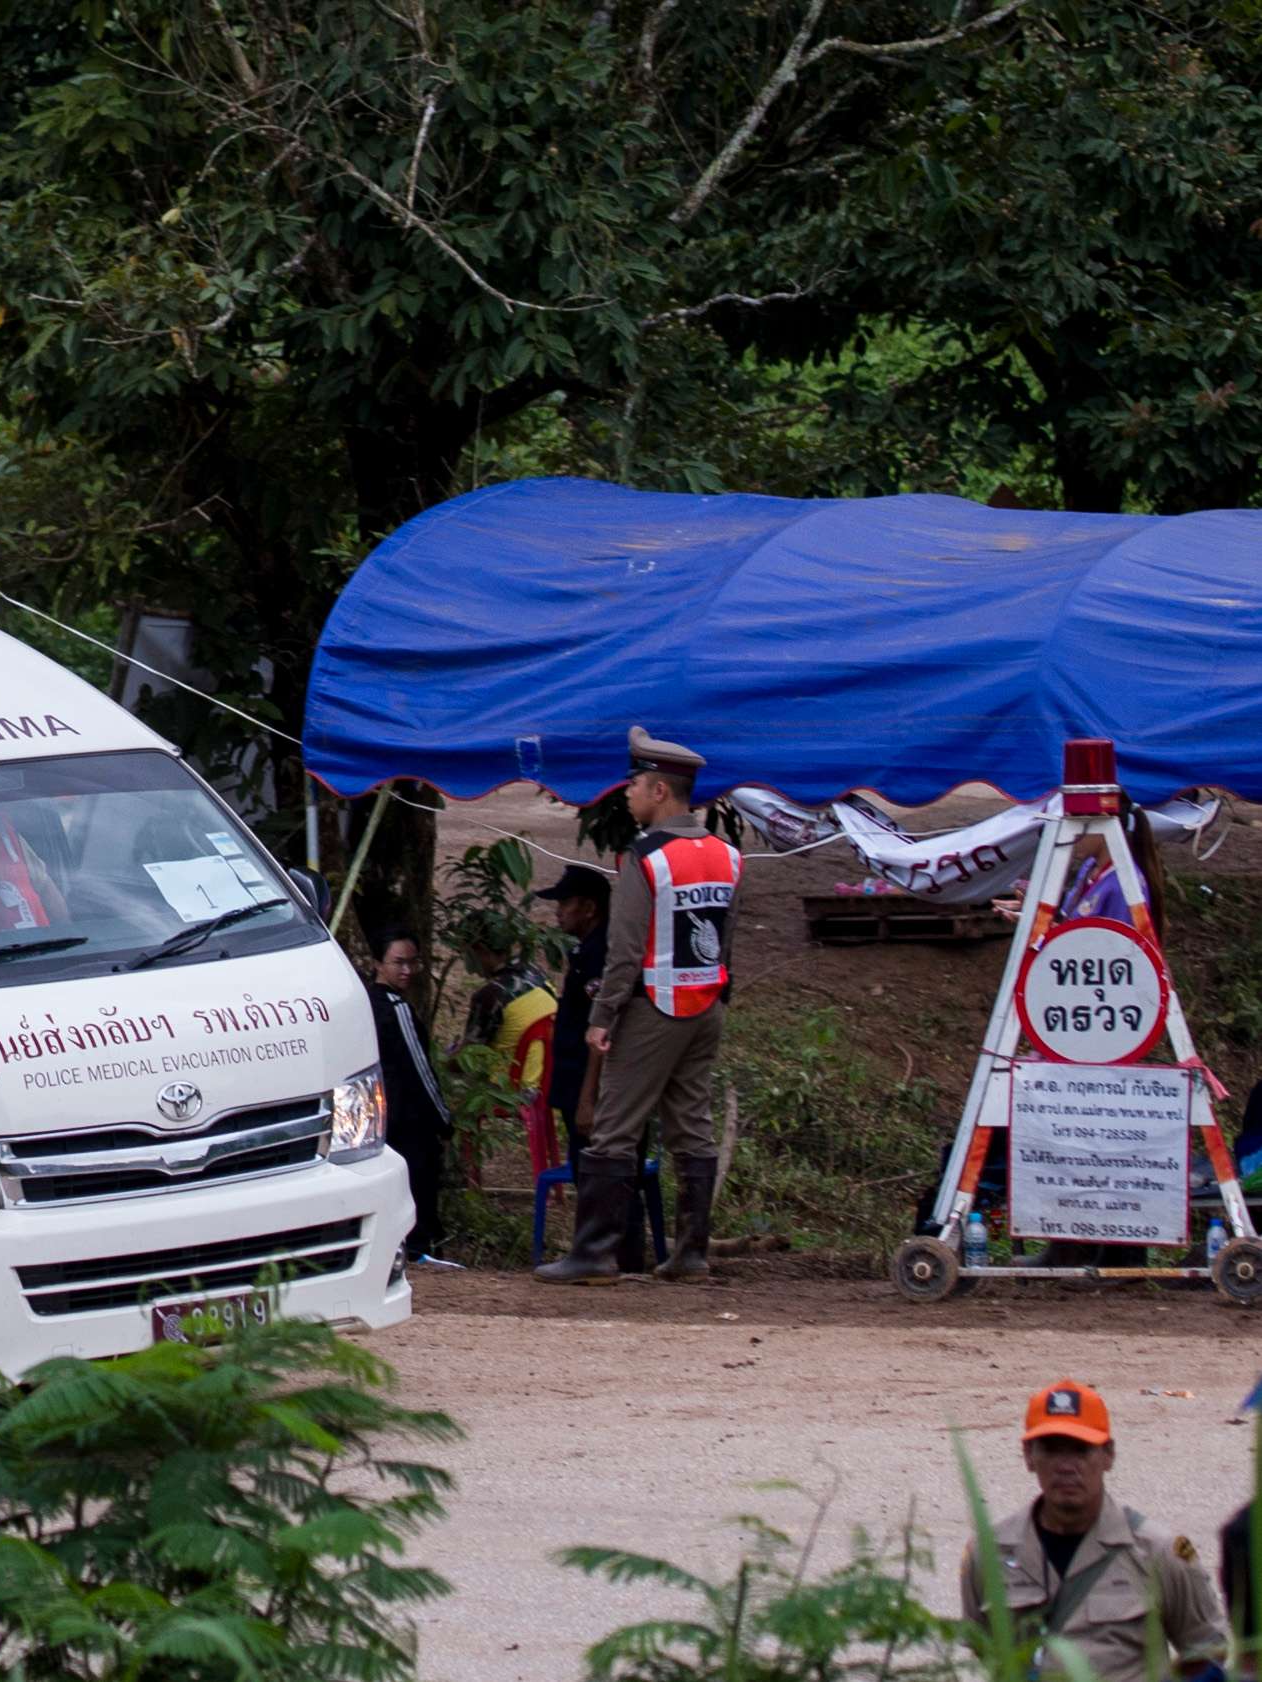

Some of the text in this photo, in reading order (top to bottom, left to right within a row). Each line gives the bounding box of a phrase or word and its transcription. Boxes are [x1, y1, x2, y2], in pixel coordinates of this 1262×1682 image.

[1049, 958, 1133, 1002] หยุด
[193, 993, 330, 1035] รพ.ตำรวจ
[1043, 1005, 1143, 1032] ตรวจ
[23, 1038, 309, 1090] POLICE MEDICAL EVACUATION CENTER
